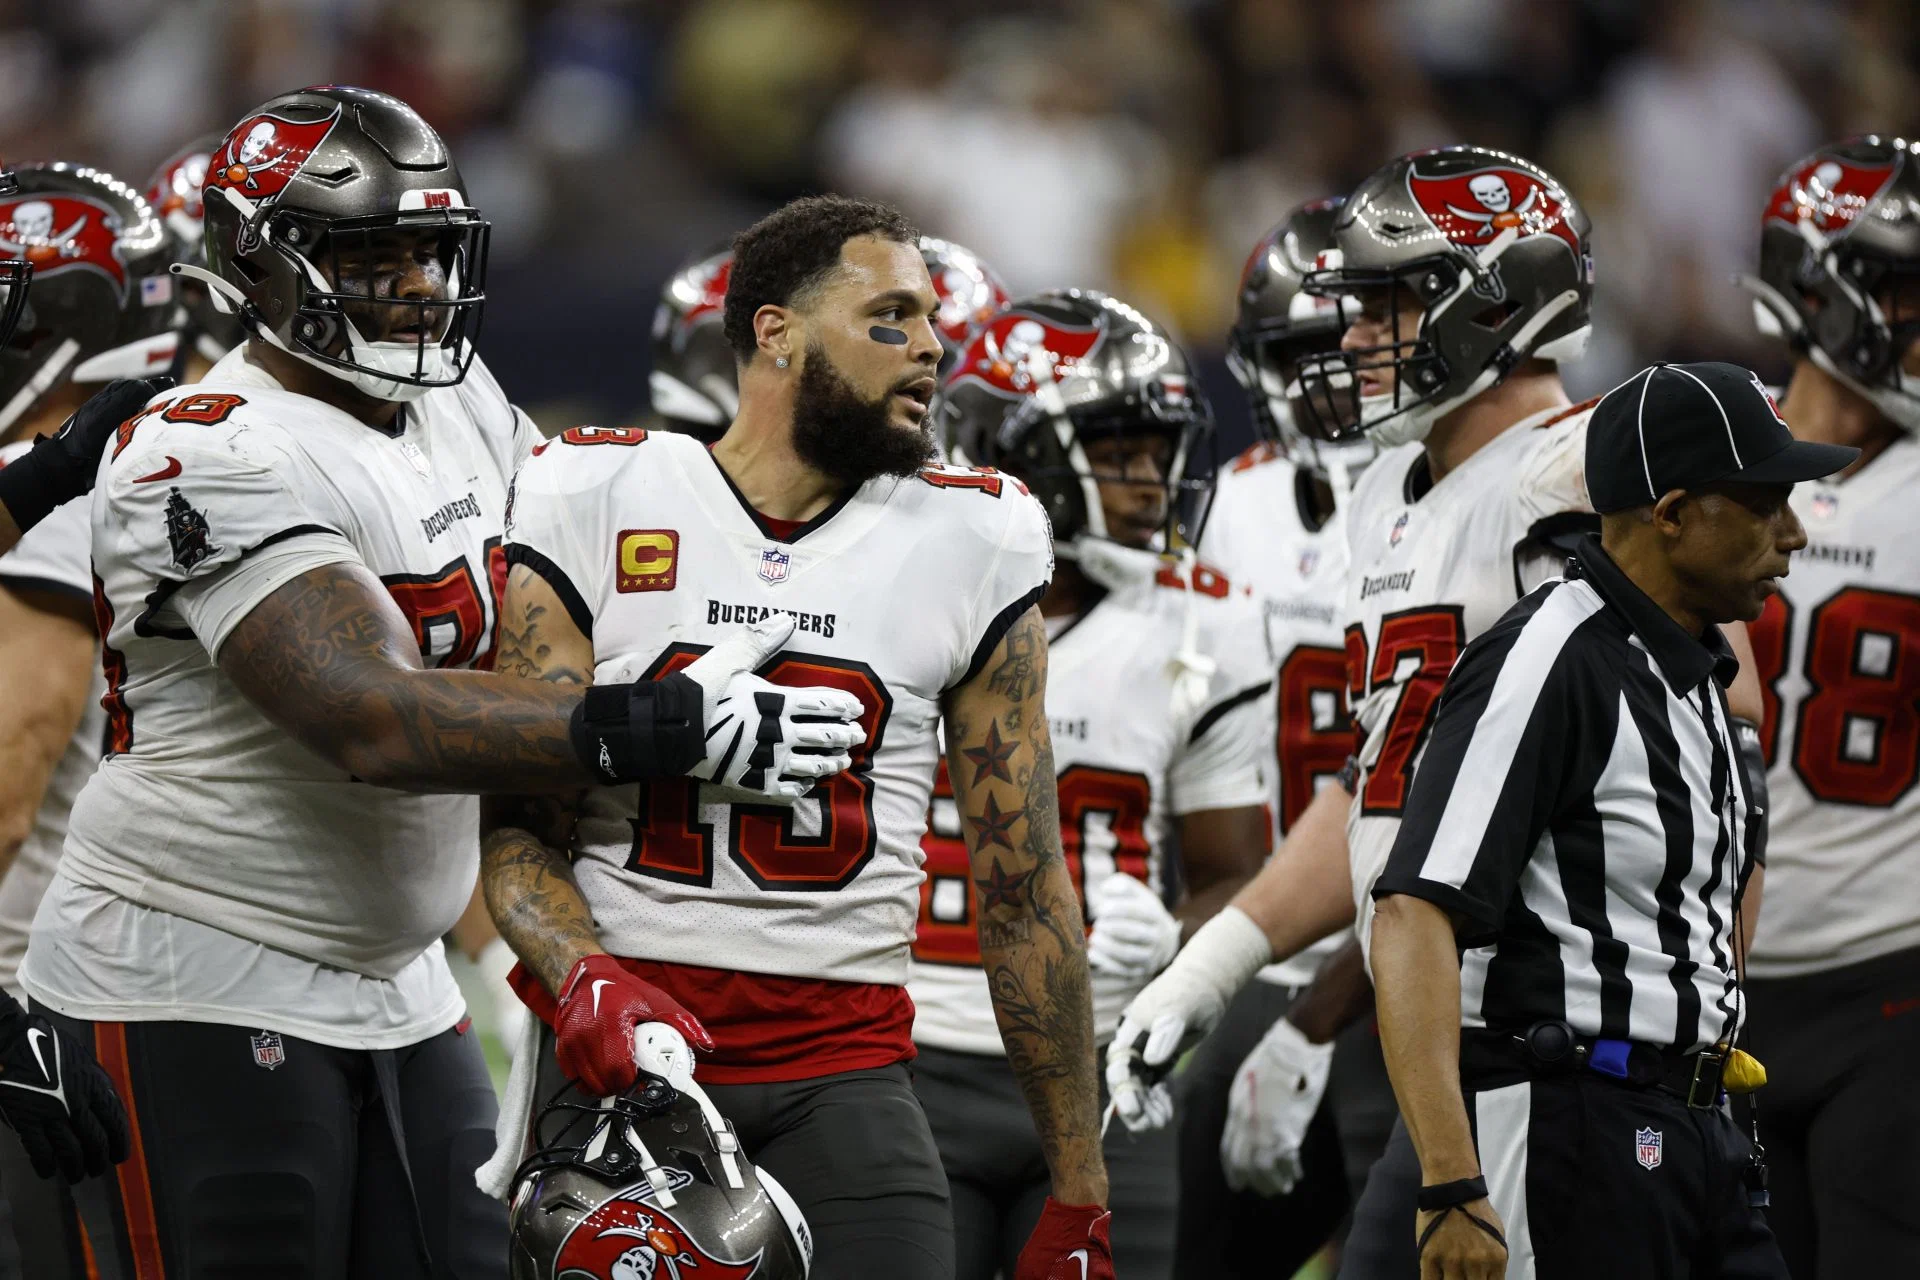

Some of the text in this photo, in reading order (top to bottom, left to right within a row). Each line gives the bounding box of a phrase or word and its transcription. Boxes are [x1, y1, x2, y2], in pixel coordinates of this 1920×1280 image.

[420, 491, 482, 543] BUCCANEERS
[621, 533, 674, 576] C
[762, 561, 785, 578] NFL
[258, 1047, 281, 1063] NFL
[1640, 1145, 1660, 1164] NFL
